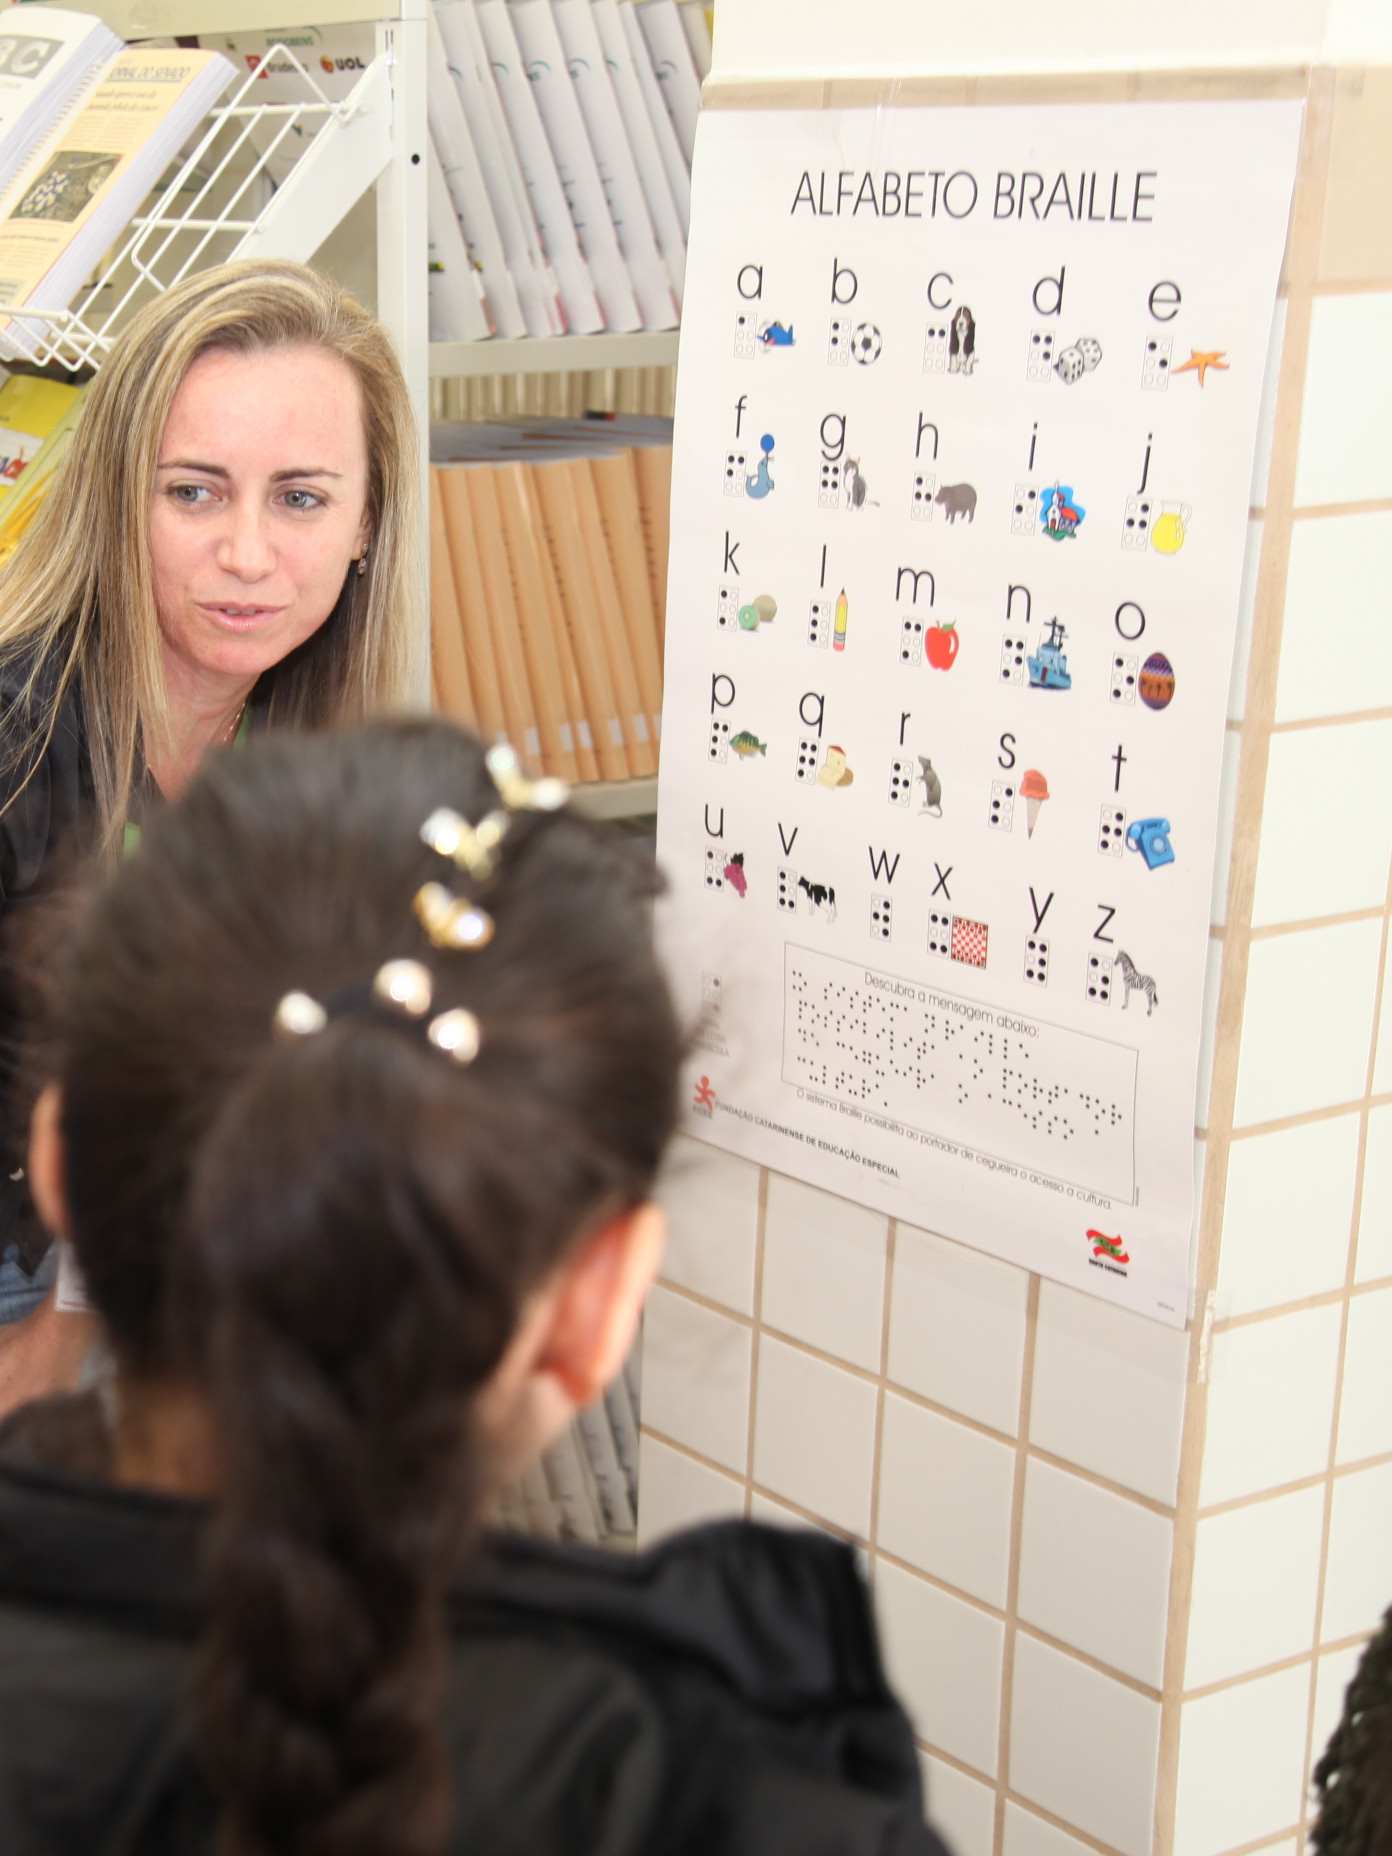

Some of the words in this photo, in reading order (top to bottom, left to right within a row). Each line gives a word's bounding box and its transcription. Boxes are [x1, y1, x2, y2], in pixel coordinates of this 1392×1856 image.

[334, 57, 365, 71] UOL
[790, 170, 979, 220] ALFABETO
[992, 171, 1158, 222] BRAILLE
[736, 264, 764, 300] a
[830, 257, 858, 305] b
[926, 272, 954, 309] c
[1032, 265, 1066, 316] d
[1147, 280, 1182, 322] e
[734, 394, 748, 439] f
[819, 413, 847, 461] g
[915, 411, 939, 461] h
[1028, 422, 1038, 471] i
[1136, 432, 1153, 496] j
[723, 530, 740, 576] k
[895, 566, 935, 608] m
[1006, 584, 1032, 624] n
[1114, 601, 1146, 641] o
[710, 673, 736, 716] p
[798, 691, 825, 739] q
[899, 711, 912, 747] r
[997, 732, 1017, 770] s
[1111, 744, 1128, 793] t
[704, 803, 724, 839] u
[777, 822, 799, 857] v
[868, 845, 901, 885] w
[930, 862, 954, 901] x
[1028, 886, 1055, 935] y
[1092, 903, 1116, 944] z
[864, 972, 915, 999] Descubra
[918, 990, 926, 1002] a
[928, 994, 993, 1024] mensagem
[996, 1014, 1040, 1039] abaixo:
[715, 1100, 754, 1123] FUNDAÇÃO
[754, 1115, 805, 1142] CATARINENSE
[806, 1135, 816, 1147] DE
[818, 1140, 861, 1164] EDUCAÇÃO
[862, 1157, 900, 1179] ESPECIAL
[796, 1088, 804, 1099] O
[806, 1092, 837, 1111] sistema
[839, 1102, 862, 1120] Braille
[864, 1113, 904, 1136] possibilita
[906, 1128, 918, 1140] ao
[920, 1134, 958, 1156] portador
[960, 1148, 974, 1160] de
[976, 1154, 1018, 1178] cegueira
[1020, 1170, 1027, 1180] o
[1029, 1174, 1064, 1194] acesso
[1076, 1189, 1112, 1210] cultura.
[1089, 1258, 1104, 1268] SANTA
